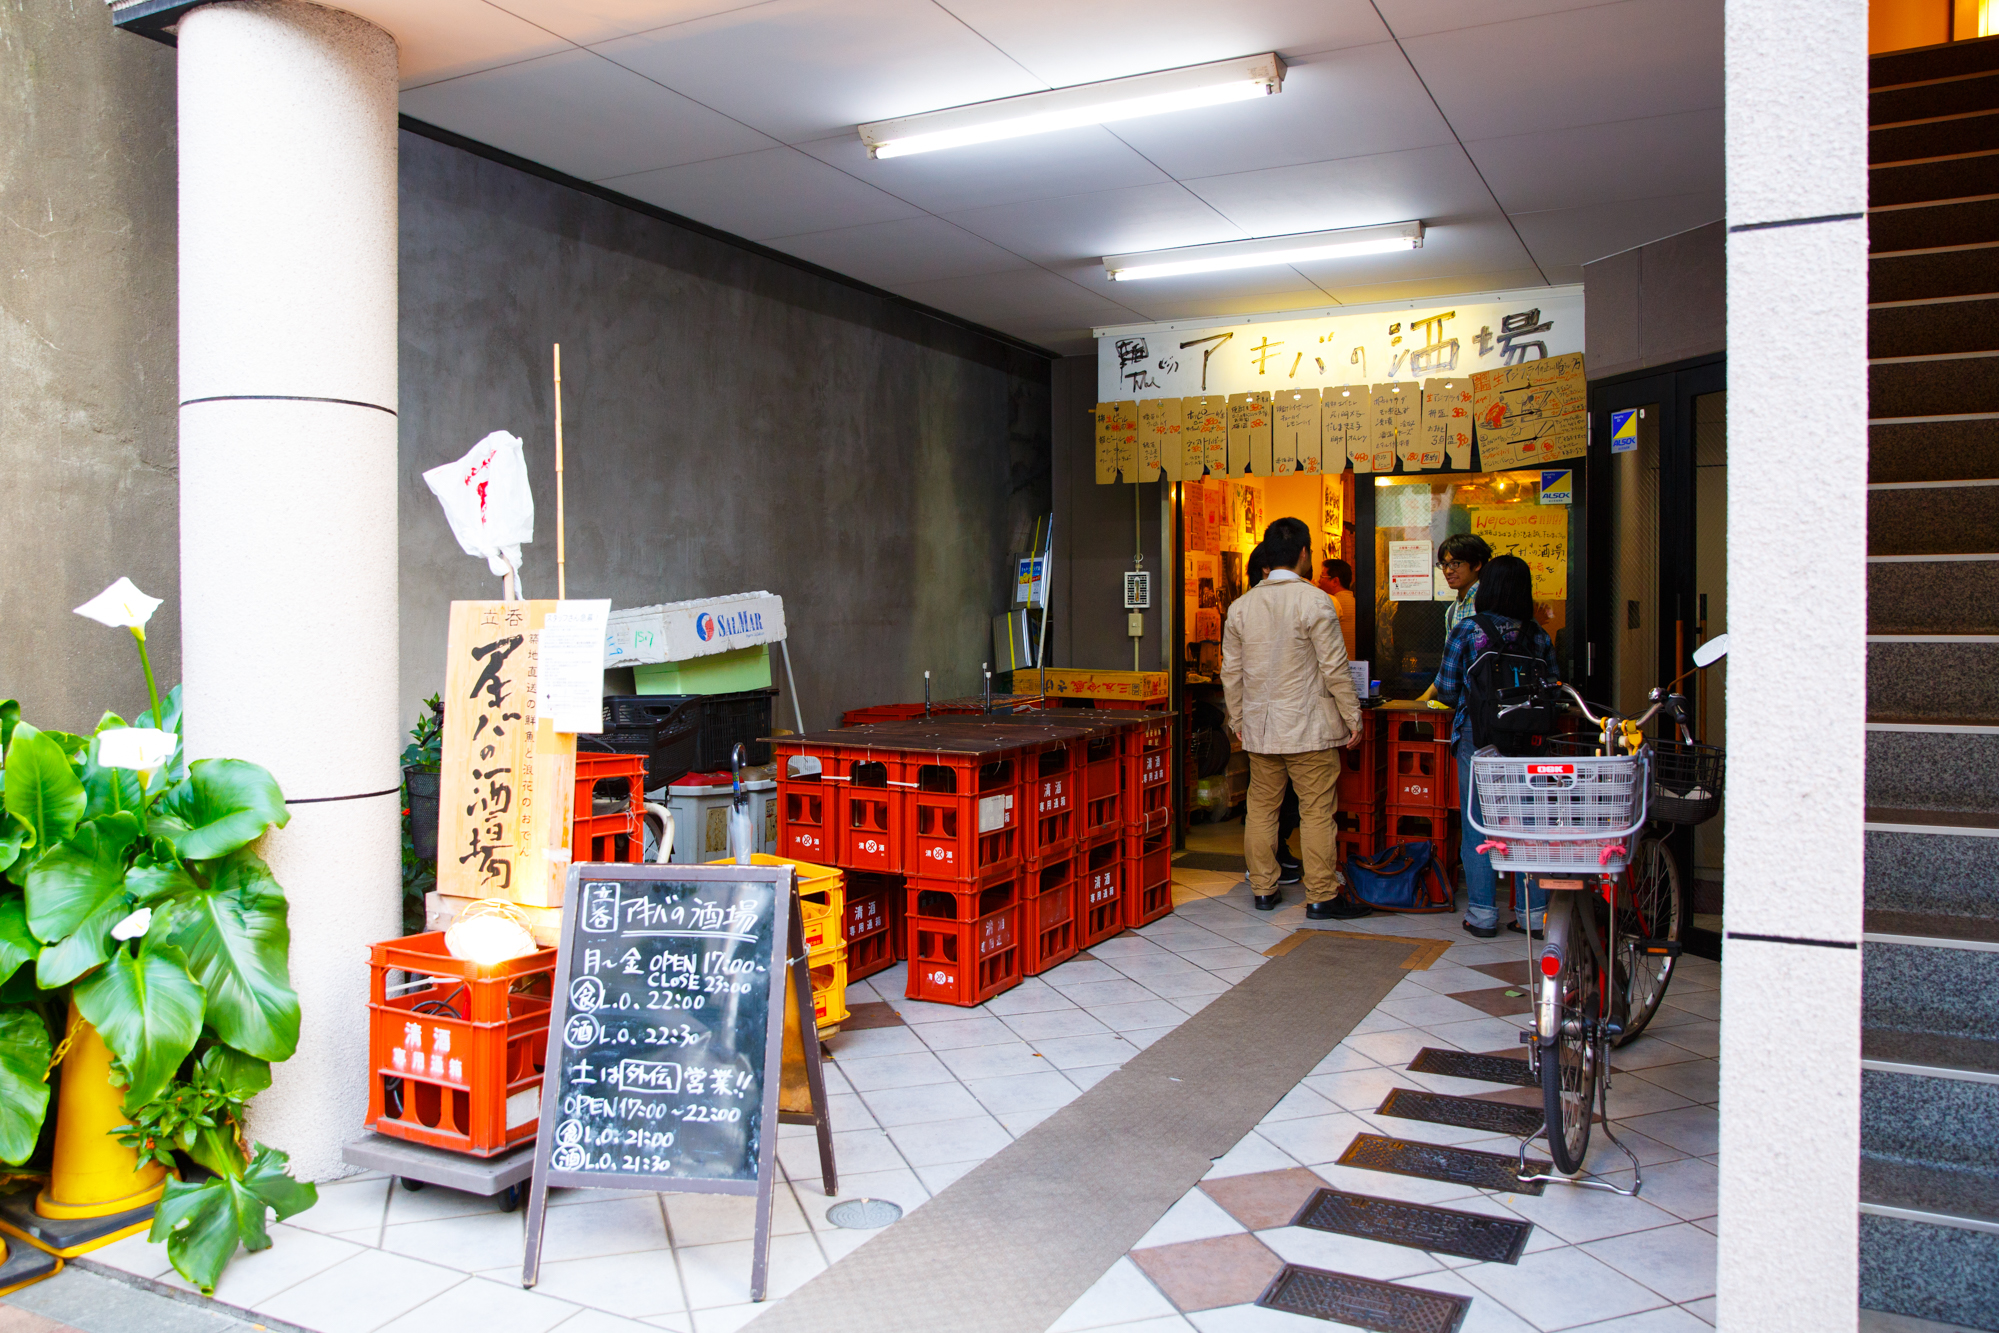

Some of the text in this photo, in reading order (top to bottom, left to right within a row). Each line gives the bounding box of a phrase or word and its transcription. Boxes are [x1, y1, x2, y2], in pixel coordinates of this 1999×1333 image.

[1179, 308, 1554, 391] アキバの酒場
[1613, 437, 1636, 447] ALSOK
[481, 608, 524, 627] 立呑
[519, 633, 540, 858] 築地直送の鮮魚と浪花のおでん
[1043, 780, 1062, 798] 清酒
[1039, 796, 1066, 812] 専用通箱
[1094, 872, 1110, 889] 清酒
[1090, 886, 1114, 903] 専用通箱
[588, 886, 759, 934] 立呑 アキバの酒場
[854, 901, 876, 920] 清酒
[849, 916, 882, 937] 専用通箱
[650, 951, 697, 974] OPEN
[648, 973, 752, 994] CLOSE 23:00
[646, 990, 705, 1010] 22:00
[404, 1022, 451, 1053] 清酒
[644, 1024, 700, 1048] 22:30
[392, 1047, 462, 1081] 専用通箱
[564, 1095, 617, 1118] OPEN
[626, 1128, 675, 1148] 21:00
[622, 1155, 671, 1172] 21:30
